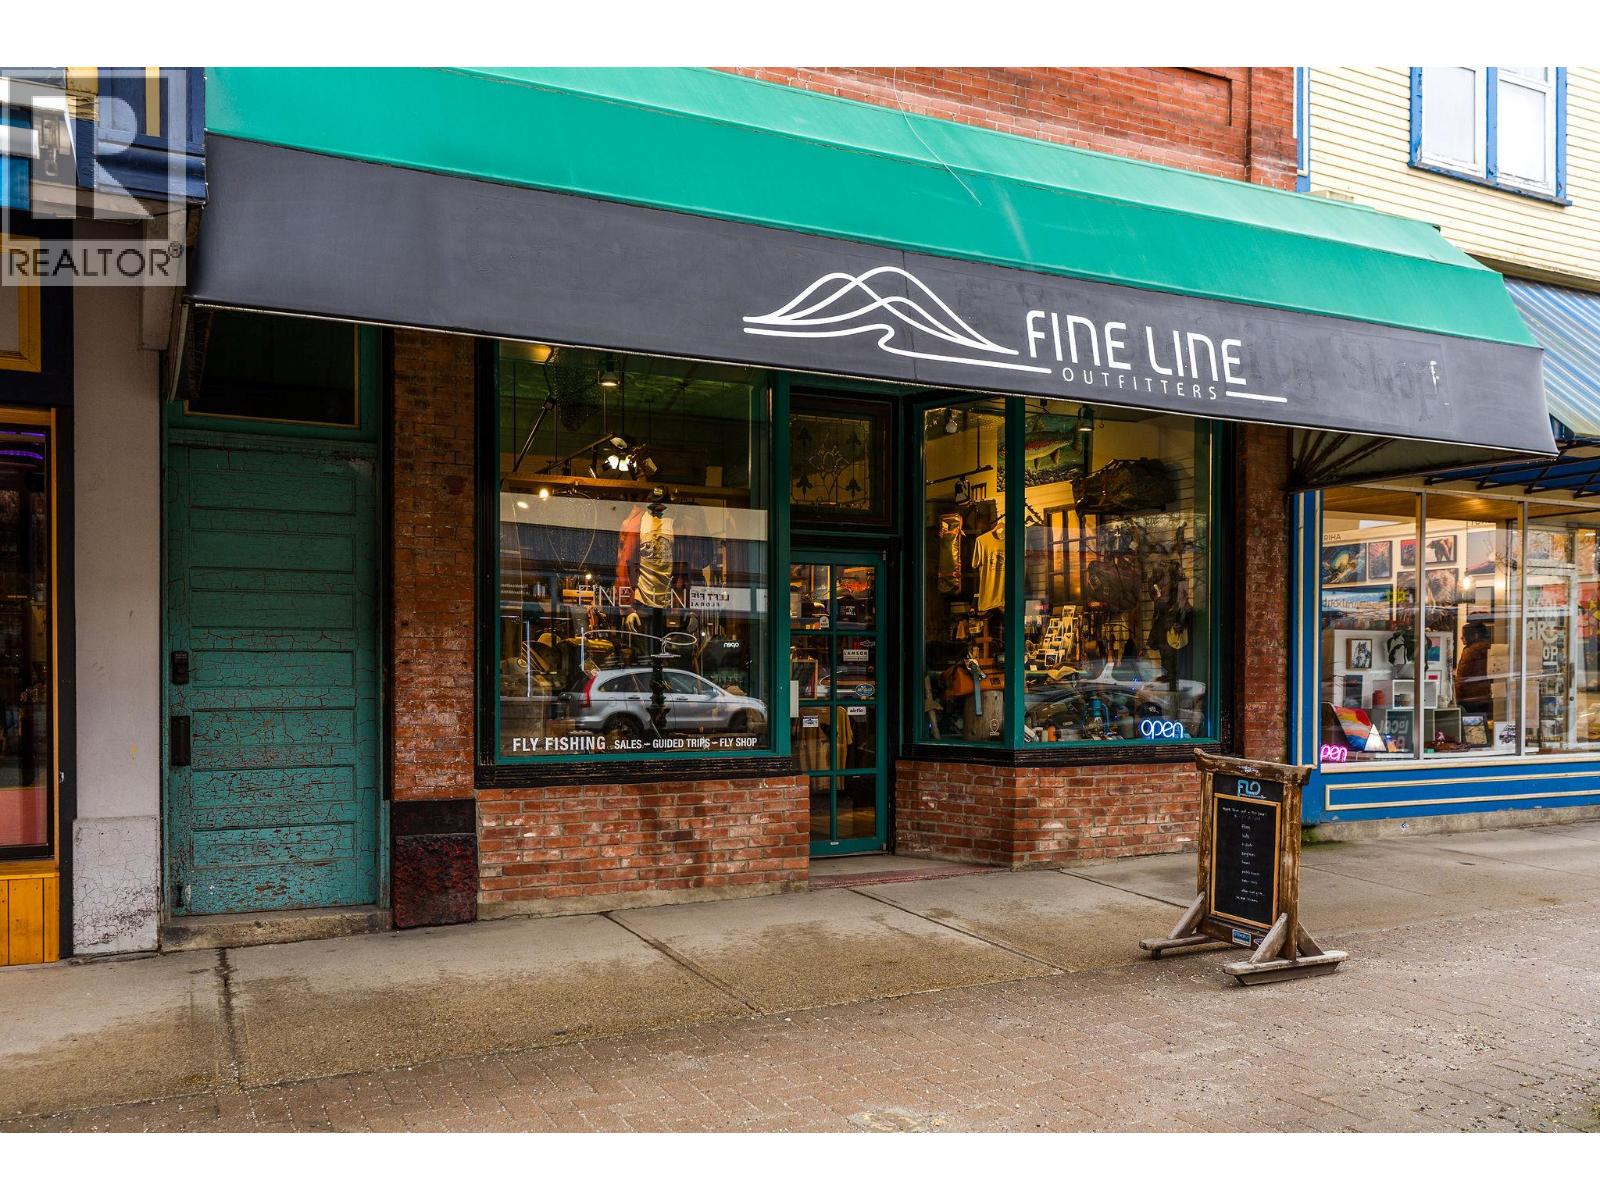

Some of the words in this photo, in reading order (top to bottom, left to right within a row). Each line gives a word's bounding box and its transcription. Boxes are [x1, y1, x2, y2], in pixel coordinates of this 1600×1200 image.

[1026, 310, 1131, 370] FINE
[1145, 326, 1247, 385] LINE
[1063, 367, 1217, 400] OUTFITTERS
[1141, 719, 1184, 739] open
[512, 737, 539, 752] FLY
[545, 736, 606, 751] FISHING
[614, 739, 642, 750] SALES
[652, 738, 684, 749] GUIDED
[686, 738, 711, 749] TRIPS
[719, 738, 734, 748] FLY
[735, 737, 758, 748] SHOP
[1320, 744, 1347, 762] pen
[1237, 779, 1261, 798] FLO
